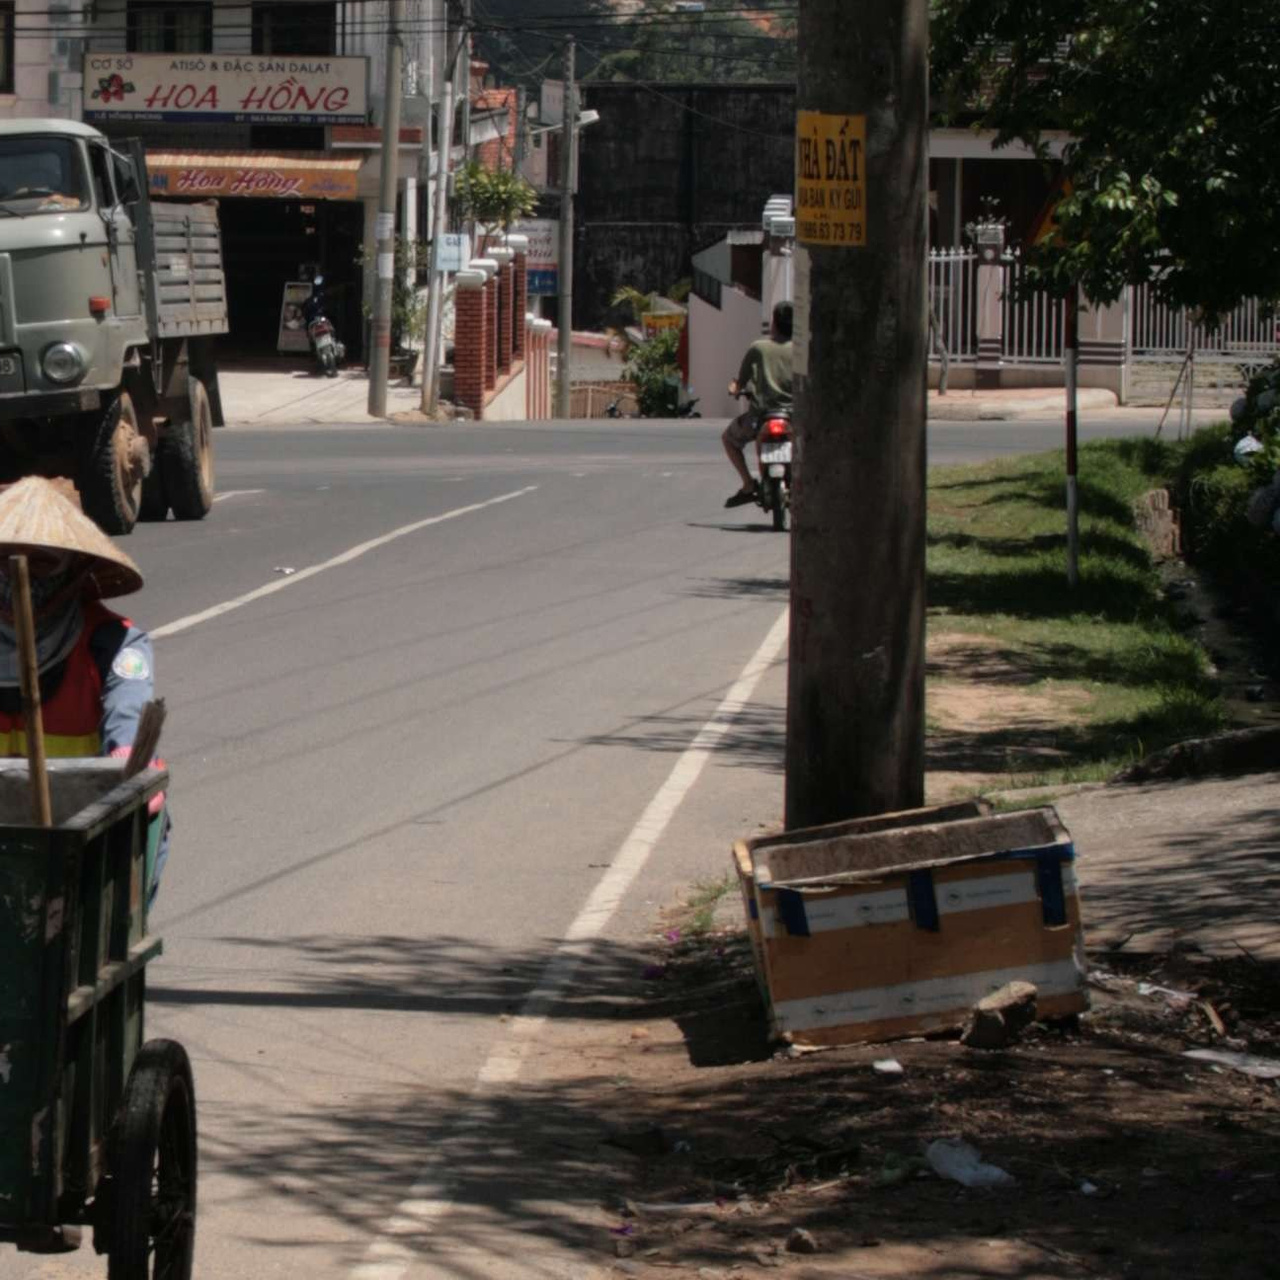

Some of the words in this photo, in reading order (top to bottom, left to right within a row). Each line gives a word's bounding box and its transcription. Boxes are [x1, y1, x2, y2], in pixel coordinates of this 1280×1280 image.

[91, 57, 112, 70] CƠ
[170, 57, 206, 71] ATISÔ
[289, 62, 331, 74] DALAT
[144, 84, 220, 109] HOA
[239, 76, 350, 112] HỒNG
[825, 118, 862, 181] ĐẤT
[177, 170, 227, 191] Hoa
[230, 170, 304, 196] Hồng
